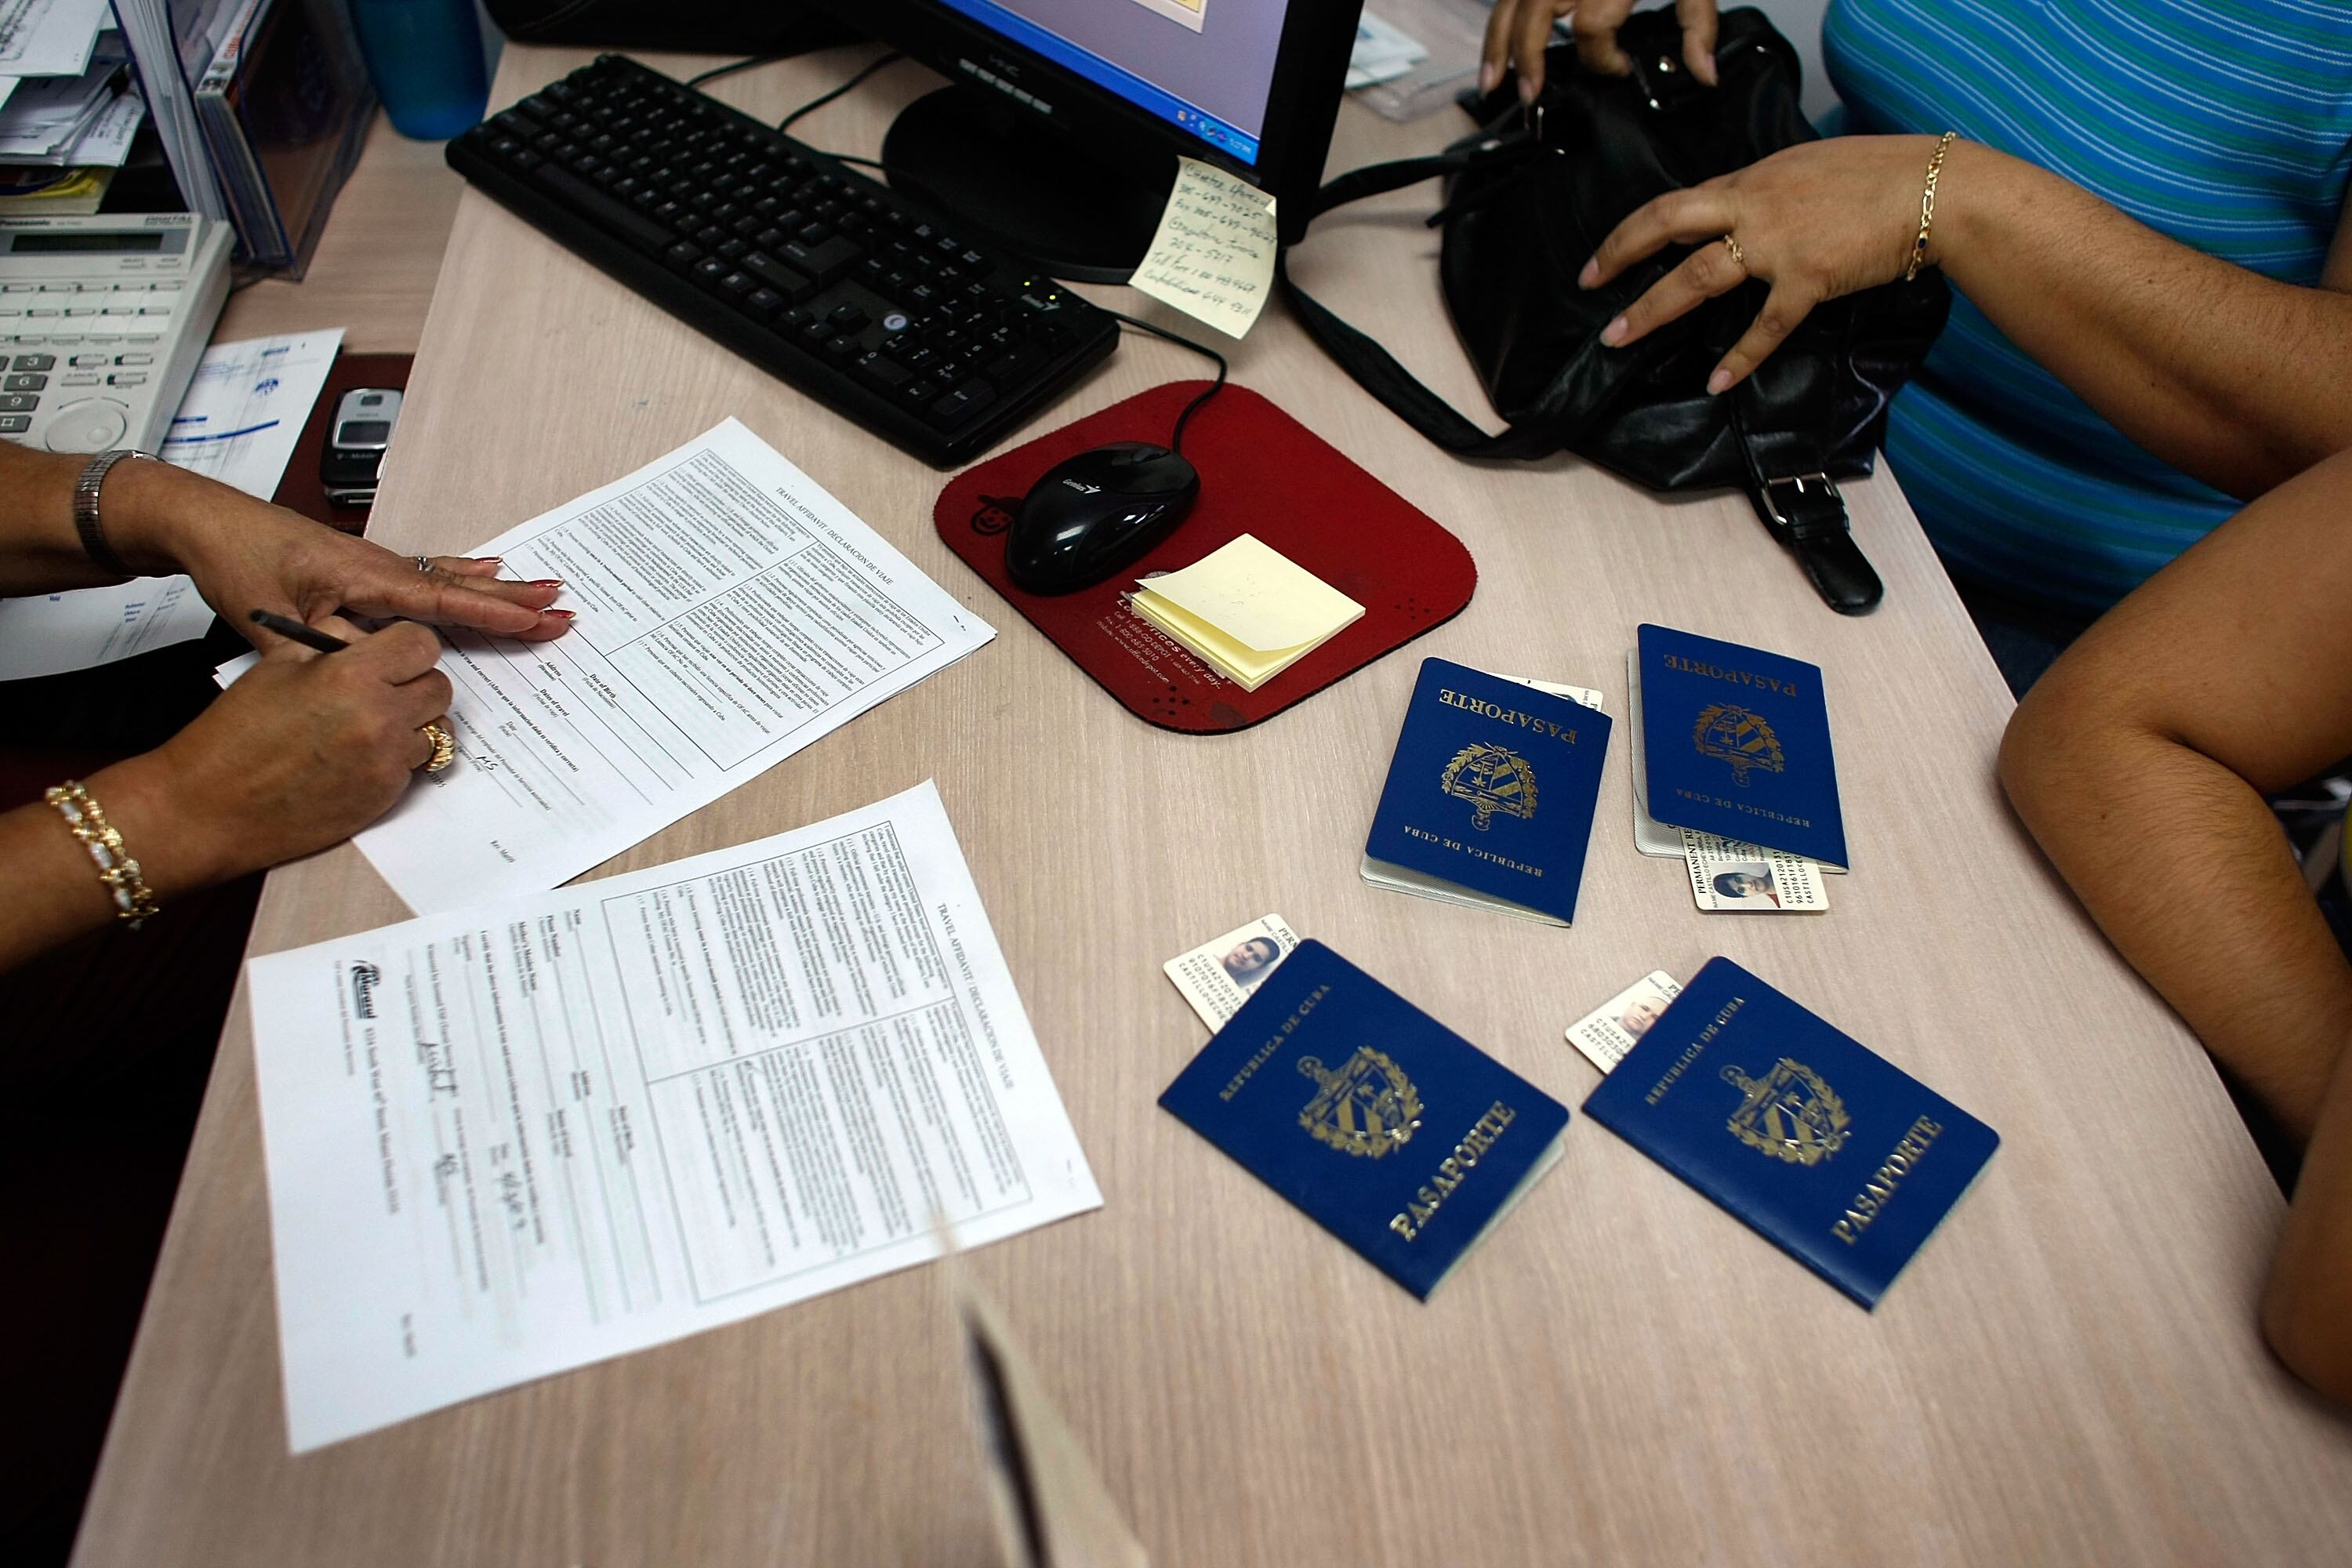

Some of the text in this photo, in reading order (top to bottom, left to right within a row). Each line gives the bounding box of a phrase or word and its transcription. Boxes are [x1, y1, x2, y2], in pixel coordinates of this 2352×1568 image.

[19, 376, 30, 386] 6
[27, 357, 38, 366] 3
[11, 396, 21, 405] 9
[775, 487, 895, 585] TRAVEL AFFIDAVIT DECLARACION DE VIAJE
[544, 660, 563, 677] Address
[589, 673, 602, 684] Date
[602, 687, 617, 699] Birth
[1178, 651, 1205, 675] every
[1662, 652, 1798, 698] PASAPORTE
[505, 720, 518, 731] Date
[539, 688, 554, 701] Dates
[554, 703, 570, 717] travel
[1439, 688, 1579, 746] PASAPORTE
[1676, 788, 1811, 828] REPUBLICA DE CUBA
[1404, 825, 1544, 877] REPUBLICA DE CUBA
[1686, 843, 1706, 894] PERMANENT
[936, 902, 956, 935] TRAVEL
[949, 936, 974, 981] AFFIDAVIT
[967, 985, 1000, 1047] DECLARACION
[1218, 984, 1330, 1102] REPUBLICA DE CUBA
[1645, 996, 1745, 1105] REPUBLICA DE CUBA
[1388, 1100, 1517, 1243] PASAPORTE
[1829, 1114, 1944, 1246] PASAPORTE
